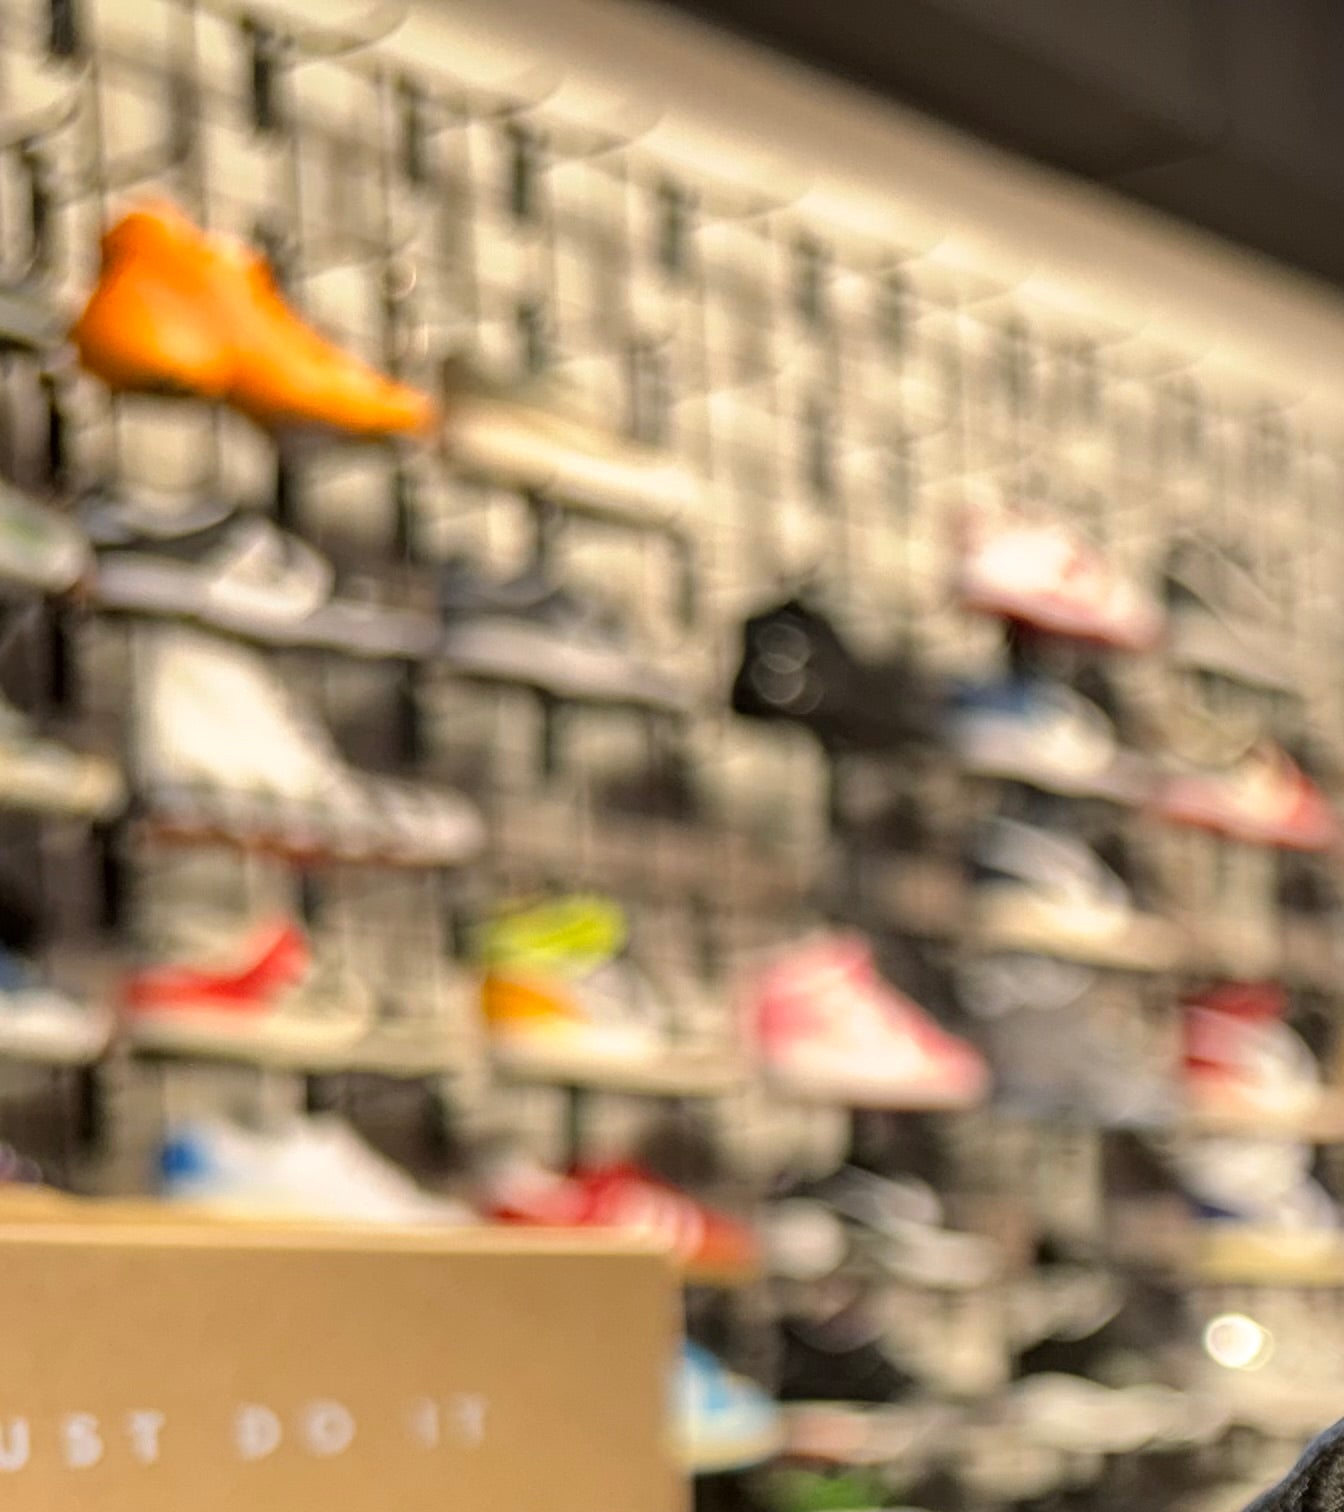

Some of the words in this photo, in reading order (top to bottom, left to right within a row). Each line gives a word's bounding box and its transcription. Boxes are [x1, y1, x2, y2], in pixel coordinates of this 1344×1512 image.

[0, 1408, 166, 1472] UST
[234, 1398, 357, 1462] DO
[408, 1392, 488, 1451] IT
